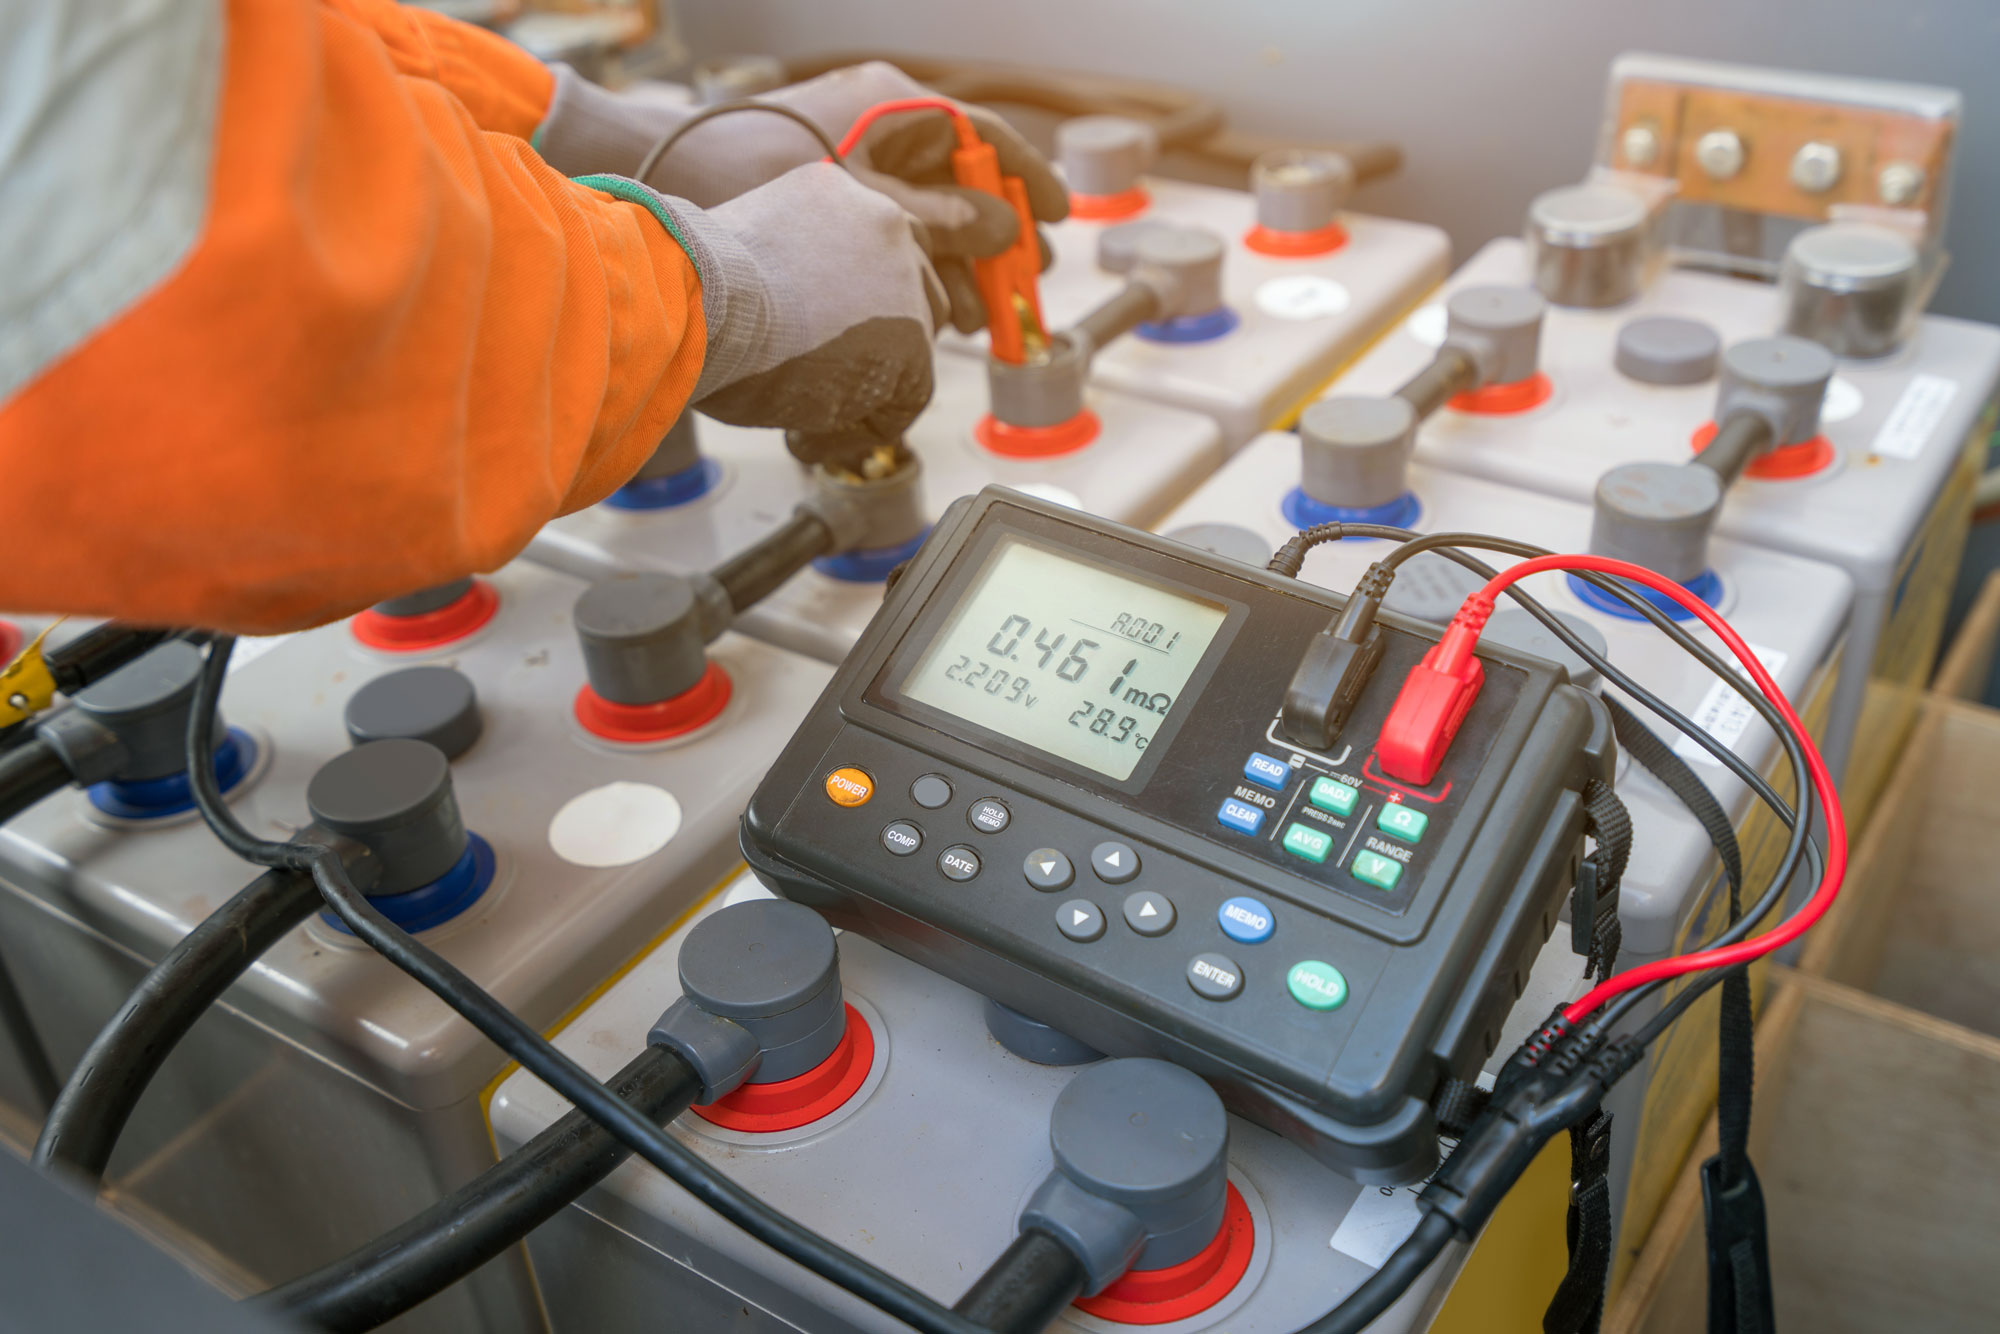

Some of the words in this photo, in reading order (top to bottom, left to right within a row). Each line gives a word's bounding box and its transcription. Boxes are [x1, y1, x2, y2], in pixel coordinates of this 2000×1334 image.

[1252, 757, 1284, 777] READ
[829, 775, 869, 798] POWER
[1234, 785, 1276, 809] MEMO
[978, 814, 1001, 828] MEMO
[982, 805, 1005, 819] HOLD
[1225, 804, 1258, 824] CLEAR
[1301, 805, 1329, 822] PRESS
[887, 830, 916, 848] COMP
[1293, 831, 1323, 850] AVG
[1365, 836, 1414, 863] RANGE
[945, 854, 974, 874] DATE
[1370, 859, 1387, 875] V
[1224, 903, 1267, 931] MEMO
[1192, 960, 1236, 989] ENTER
[1294, 968, 1339, 997] HOLD
